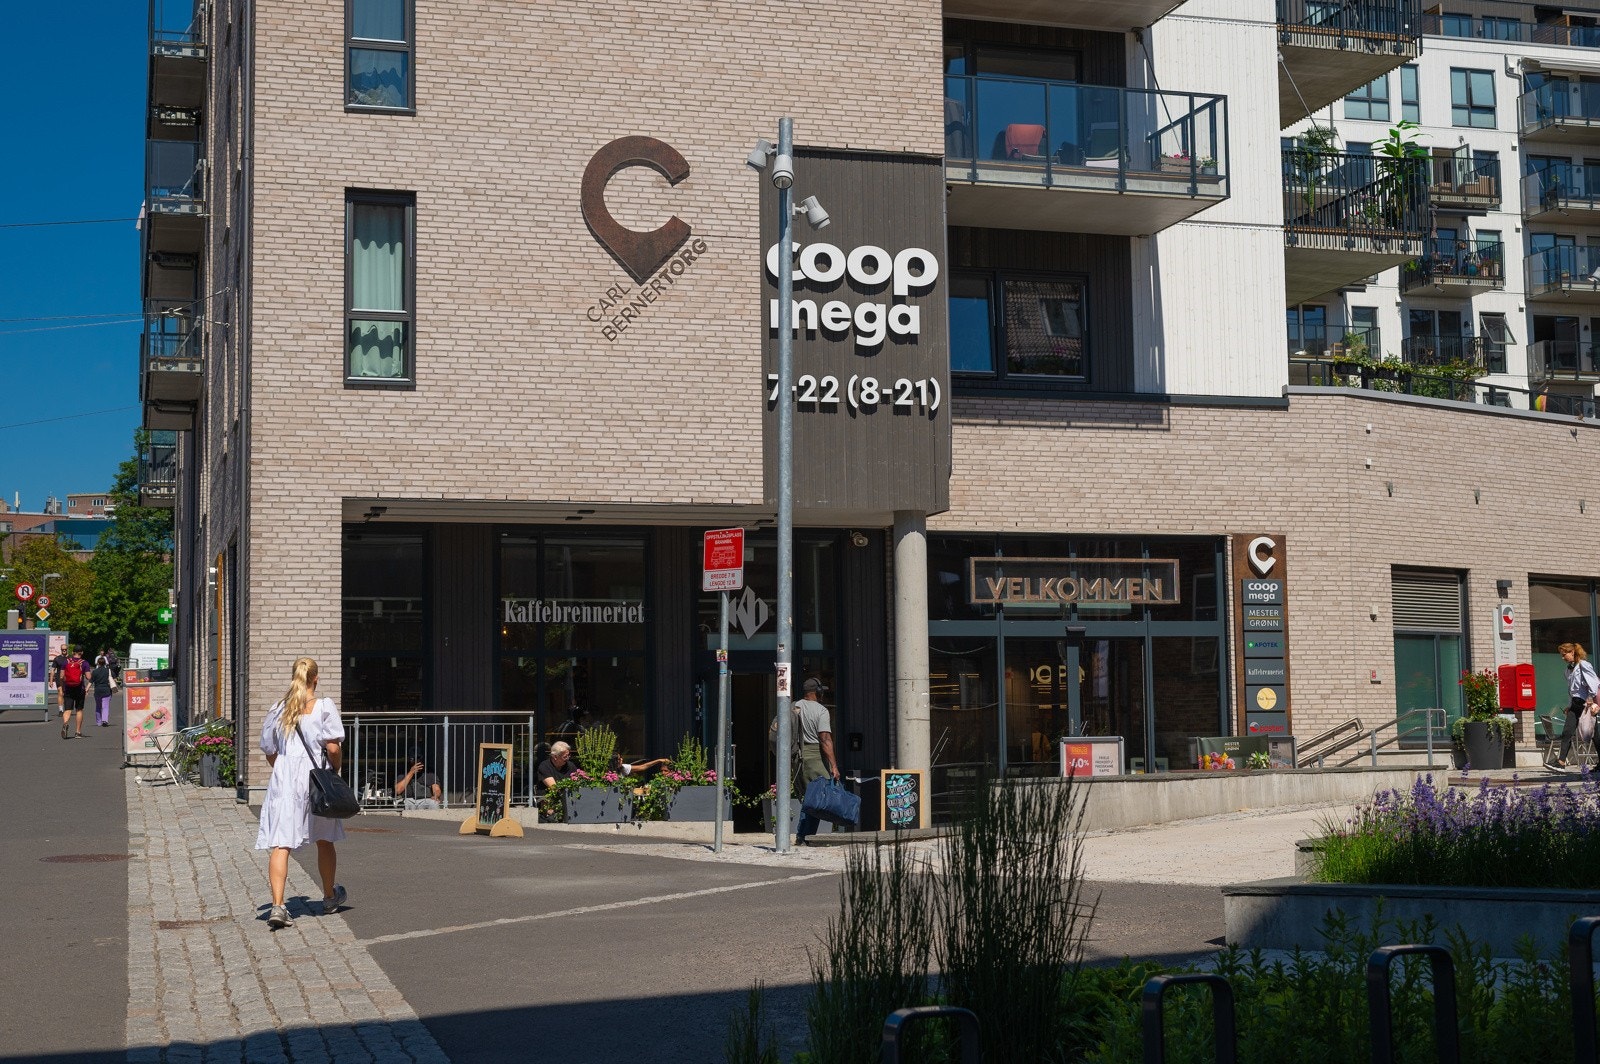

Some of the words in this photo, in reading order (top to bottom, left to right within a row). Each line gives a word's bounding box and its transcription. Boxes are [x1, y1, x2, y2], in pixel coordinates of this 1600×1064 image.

[766, 241, 939, 296] coop
[586, 282, 631, 322] CARL
[601, 238, 708, 342] BERNERTORG
[770, 299, 920, 347] mega
[767, 373, 840, 403] 7-22
[847, 374, 941, 411] (8-21)
[986, 577, 1163, 601] VELKOMMEN
[1248, 582, 1278, 592] coop
[1248, 593, 1275, 602] mega
[504, 599, 645, 624] Kaffebrenneriet
[1248, 668, 1284, 676] Kaffebrenneriet
[1069, 758, 1089, 768] -40%
